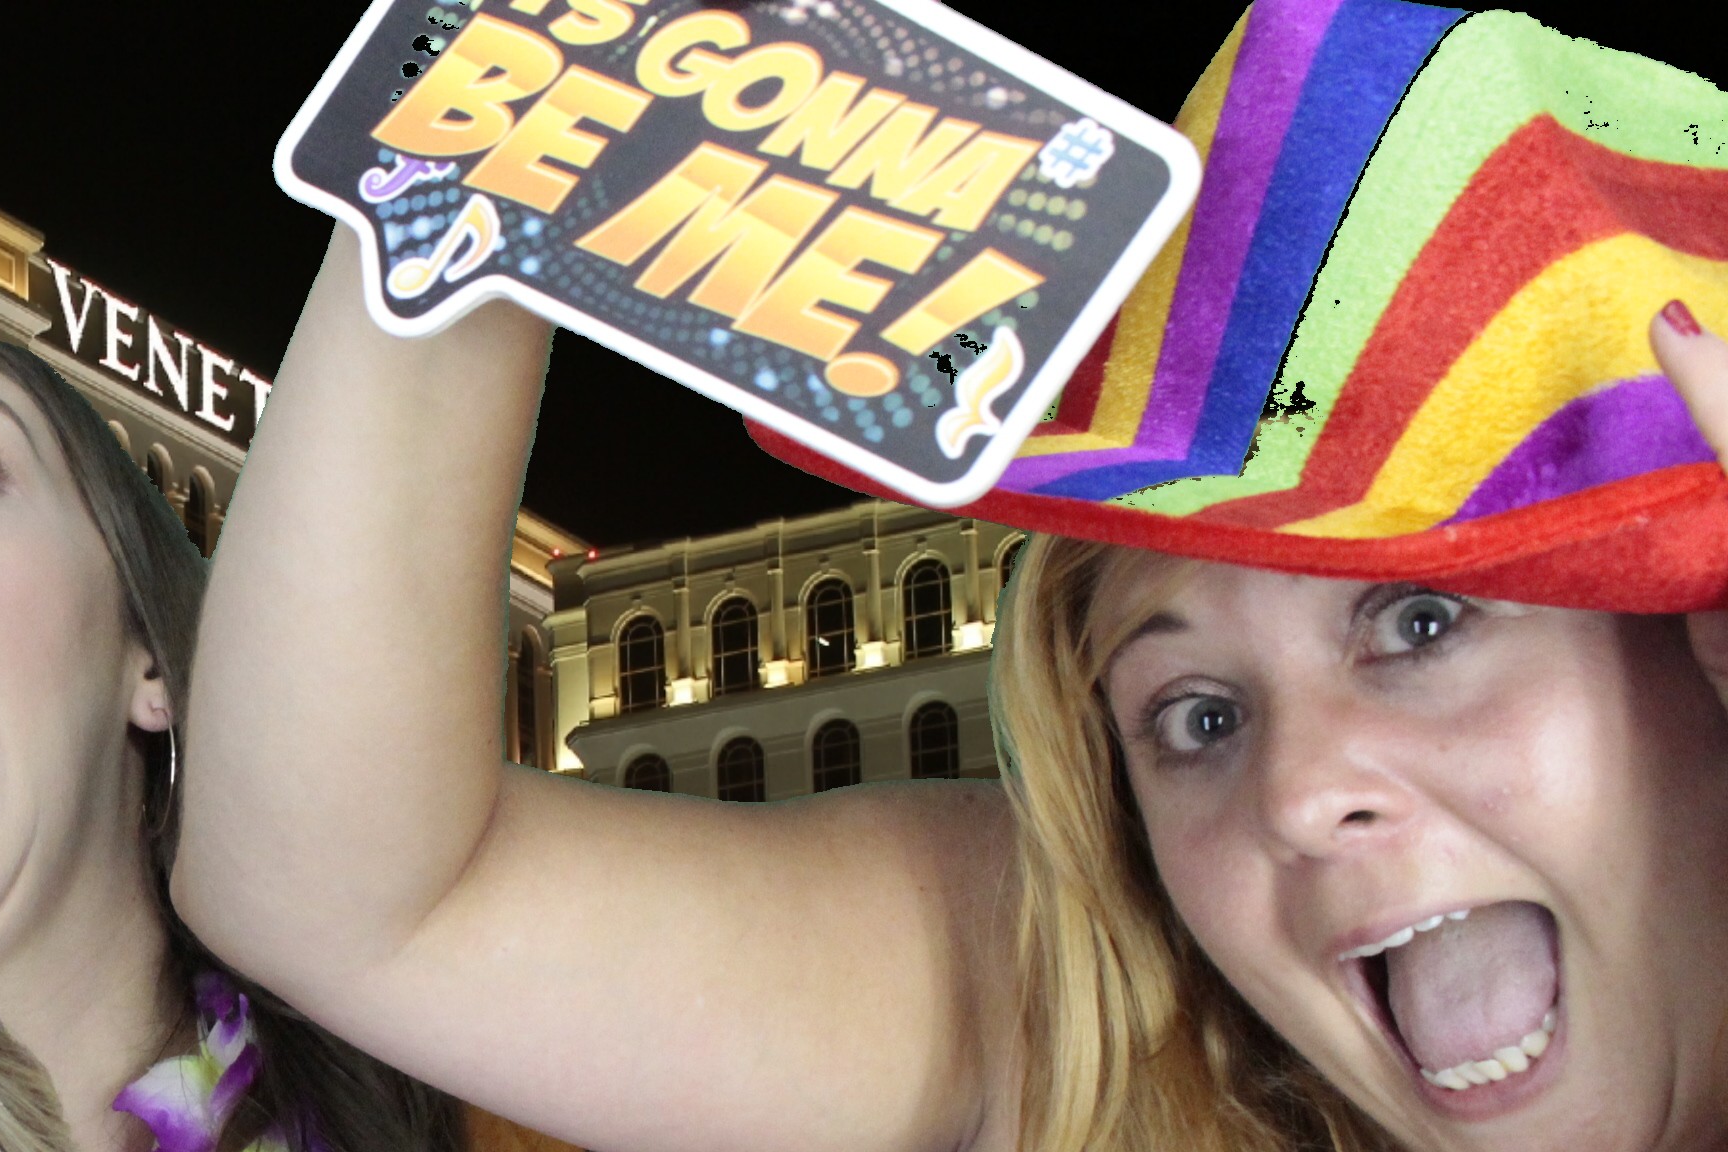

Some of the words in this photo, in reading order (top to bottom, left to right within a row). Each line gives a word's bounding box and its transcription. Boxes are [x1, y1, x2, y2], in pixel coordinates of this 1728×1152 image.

[370, 12, 655, 215] BE
[574, 141, 1046, 397] ME!
[634, 8, 1043, 233] GONNA
